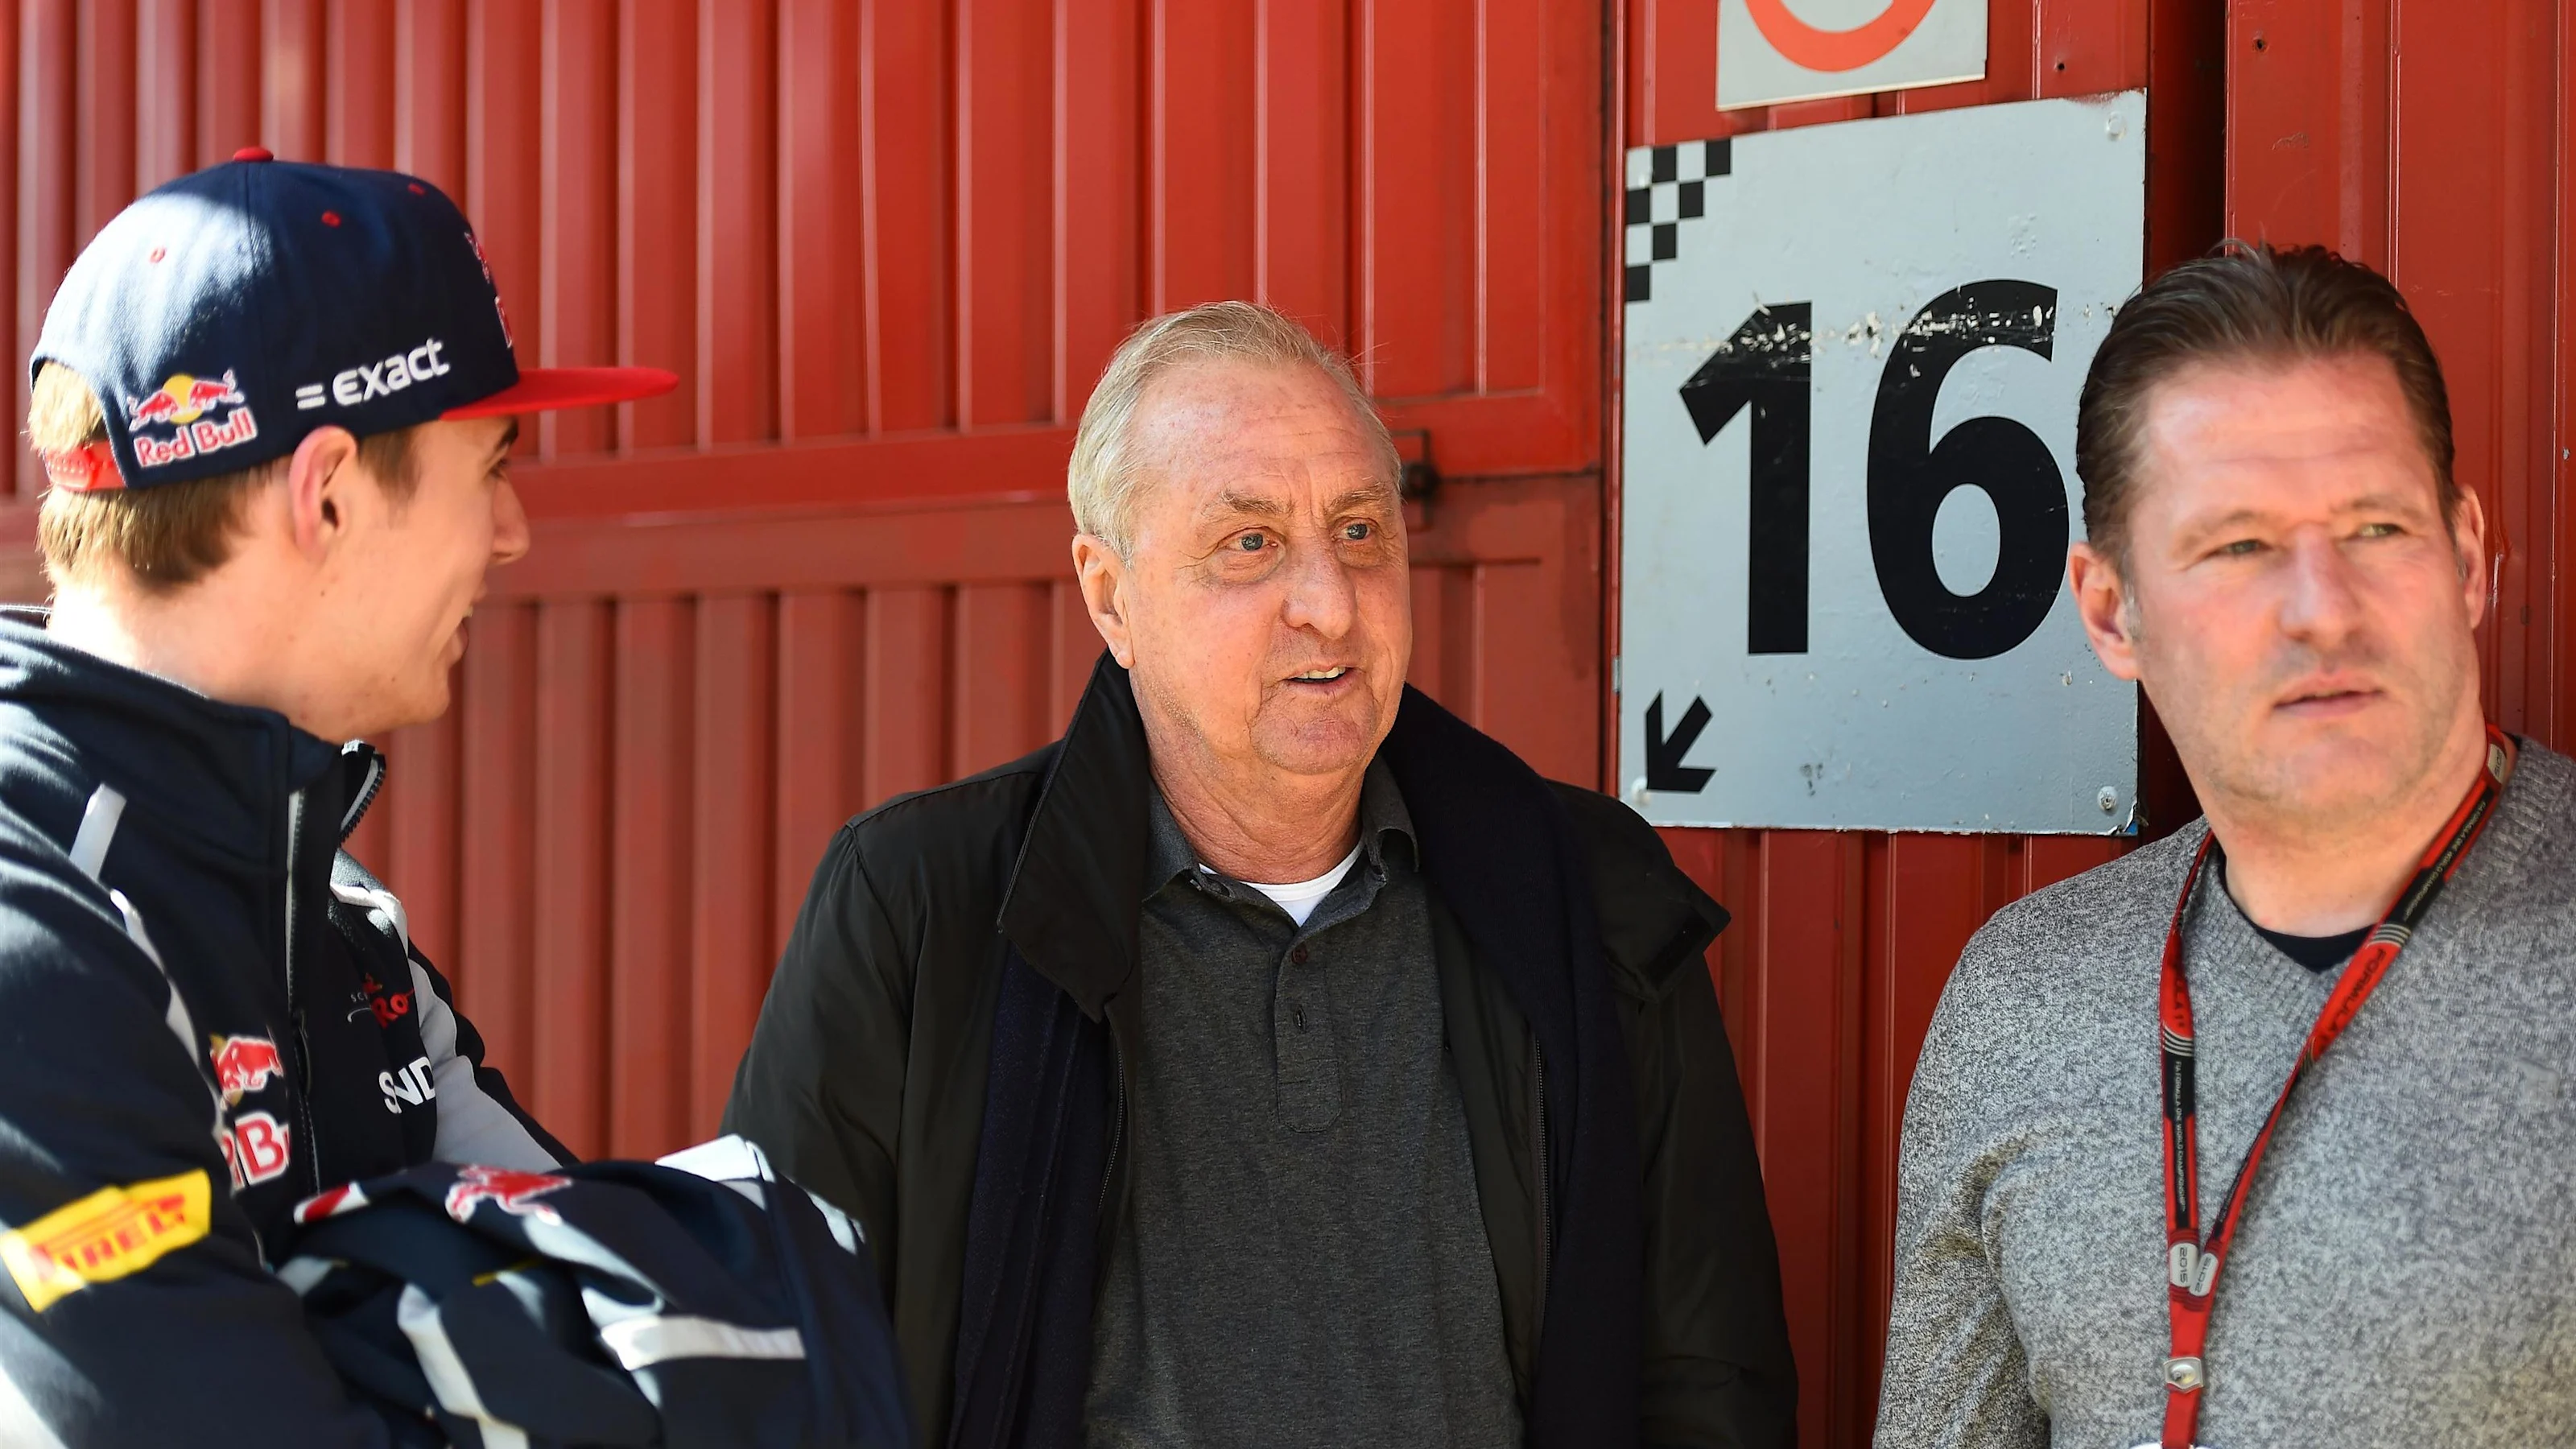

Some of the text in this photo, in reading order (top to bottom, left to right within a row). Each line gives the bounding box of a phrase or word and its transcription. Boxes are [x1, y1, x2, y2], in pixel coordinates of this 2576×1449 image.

[135, 408, 256, 466] Red Bull
[1679, 279, 2070, 660] 16
[2328, 948, 2387, 1032] FORMULA
[2179, 1247, 2188, 1283] 2015
